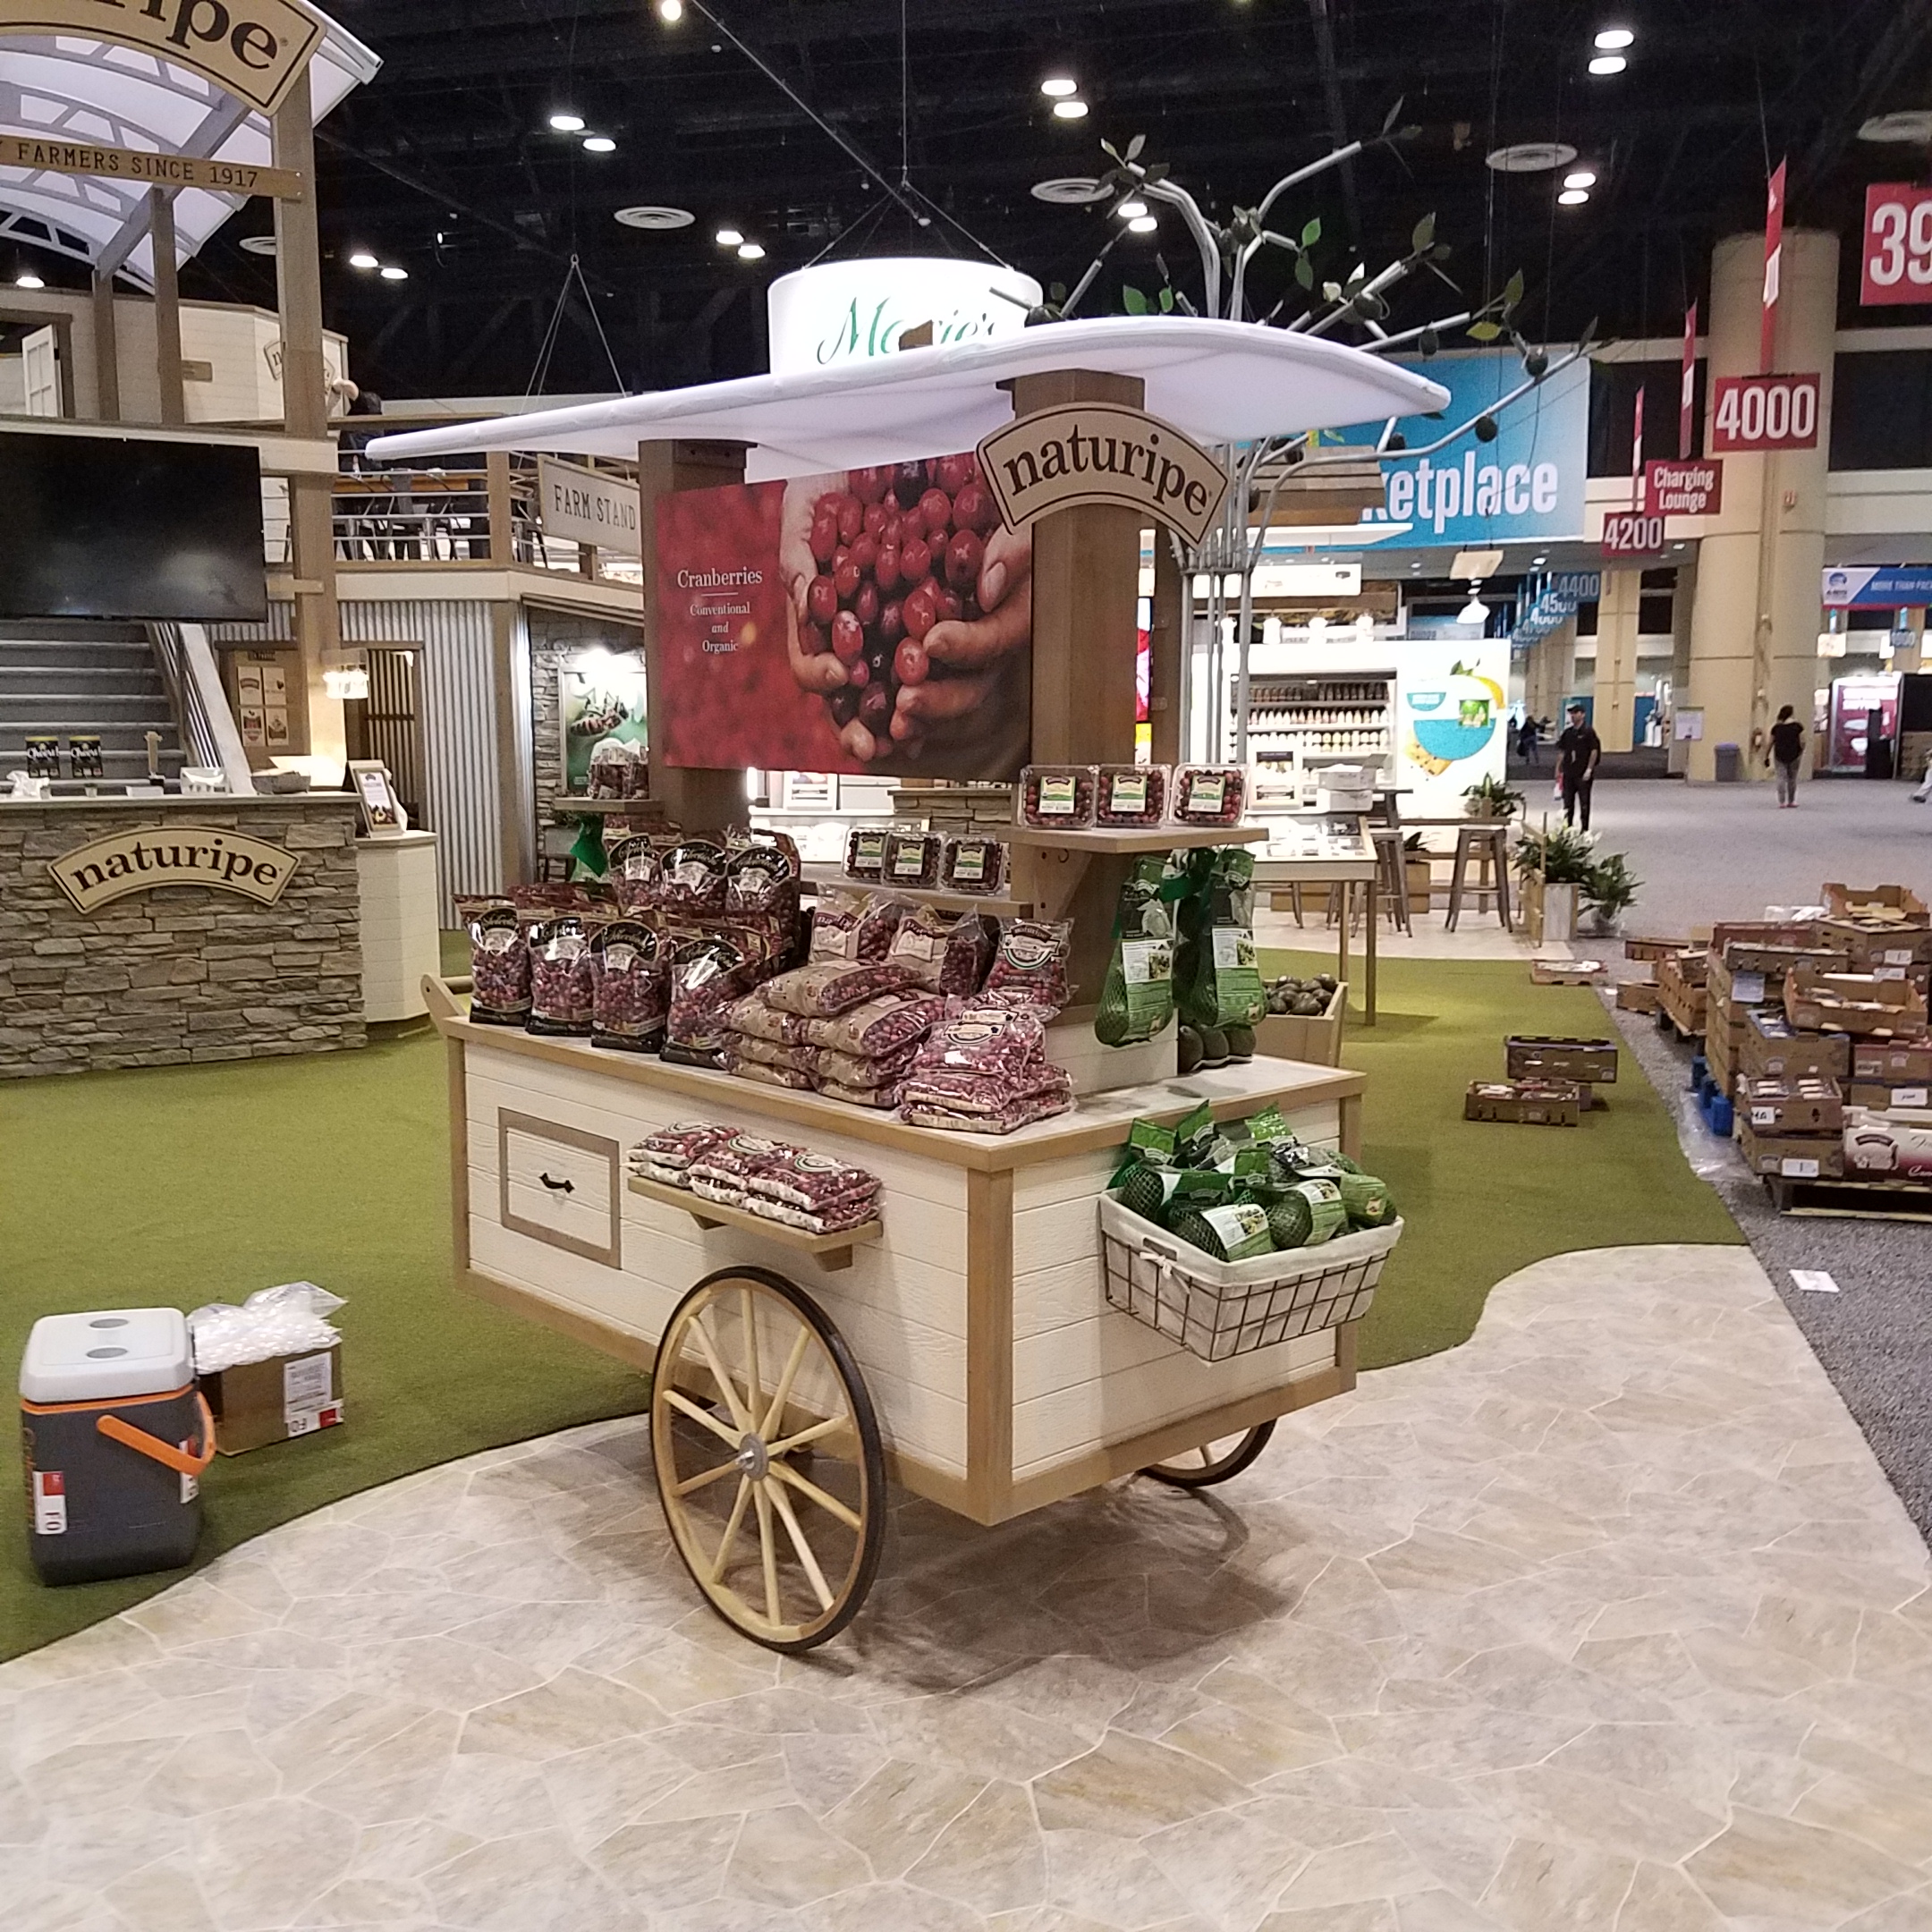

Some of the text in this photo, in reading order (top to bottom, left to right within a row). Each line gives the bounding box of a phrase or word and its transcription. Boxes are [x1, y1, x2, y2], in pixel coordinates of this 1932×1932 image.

[18, 142, 258, 188] FARMERS SINCE 1917
[1716, 384, 1816, 441] 4000
[1003, 423, 1208, 516] naturipe
[1653, 465, 1715, 491] Charging
[554, 484, 637, 530] FARM STAND
[1658, 483, 1707, 513] Lounge
[1604, 516, 1663, 550] 4200
[676, 566, 763, 589] Cranberries
[1558, 574, 1600, 597] 4400
[689, 601, 750, 616] Conventional
[711, 622, 729, 633] and
[701, 640, 739, 655] Organic
[71, 838, 278, 892] naturipe
